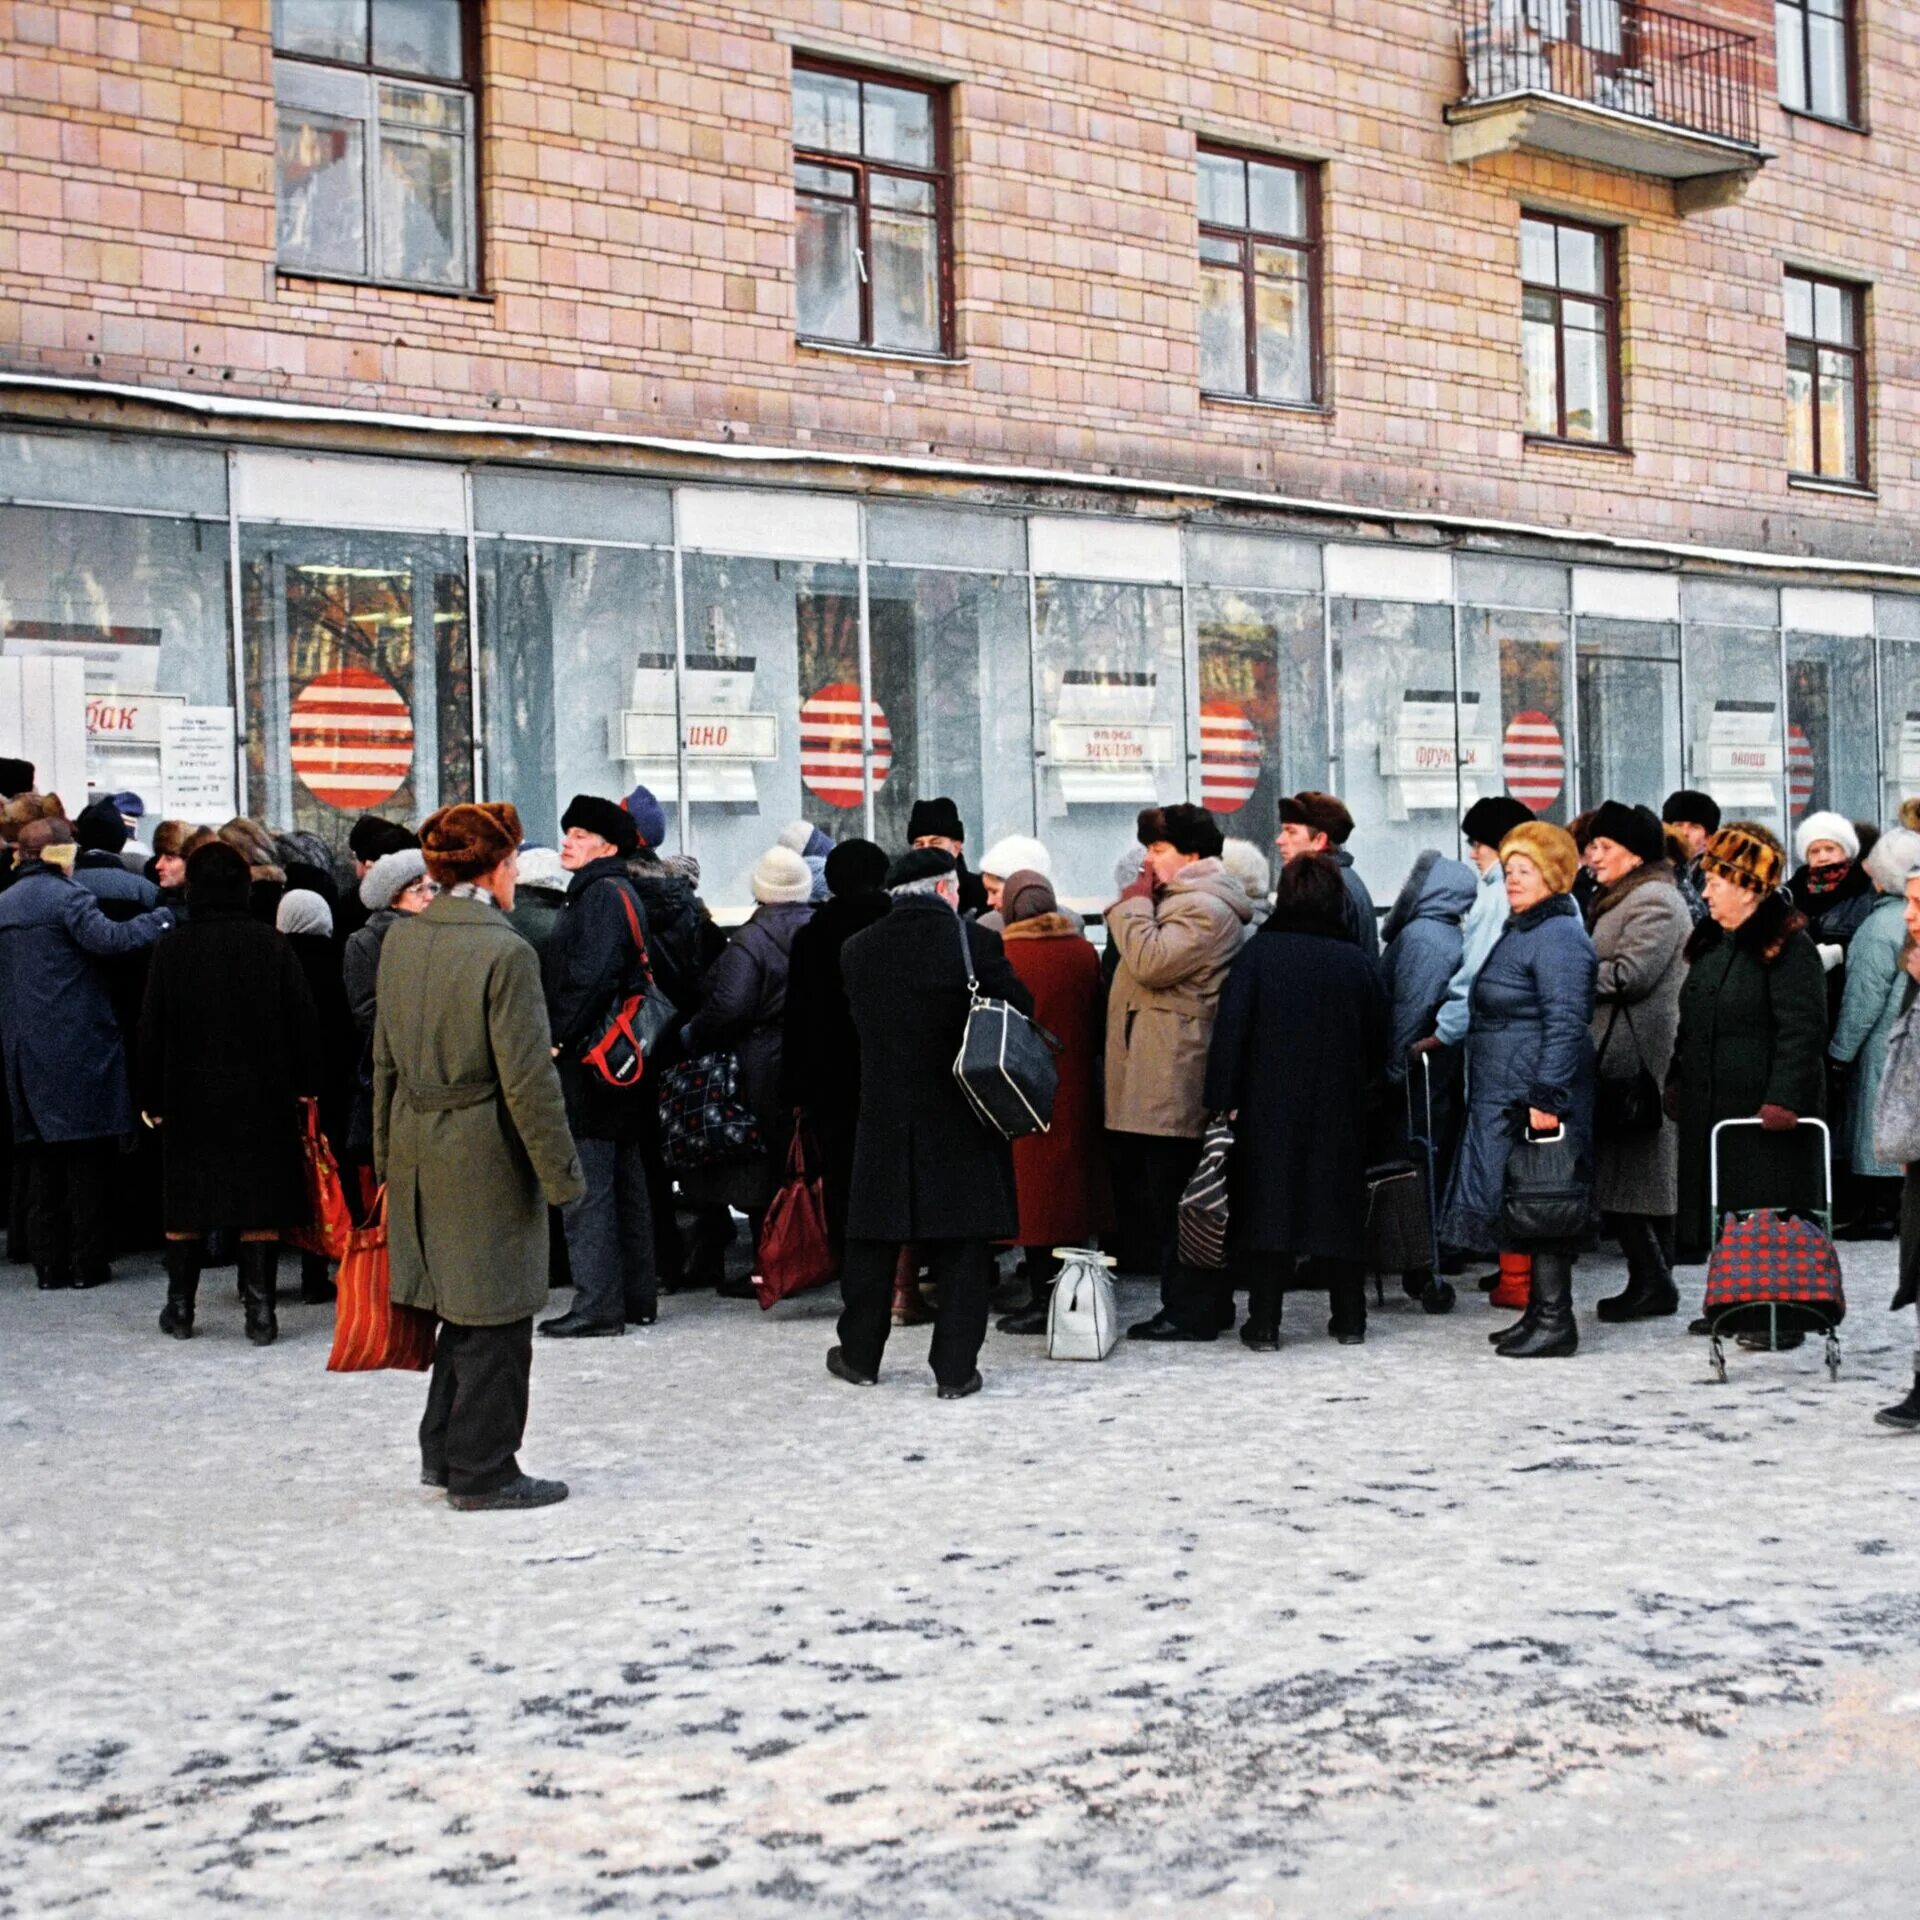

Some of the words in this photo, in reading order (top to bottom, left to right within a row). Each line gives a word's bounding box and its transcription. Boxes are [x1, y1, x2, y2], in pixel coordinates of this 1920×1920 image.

[85, 699, 138, 735] бак
[689, 726, 728, 746] ино
[1415, 746, 1476, 768] фрукы
